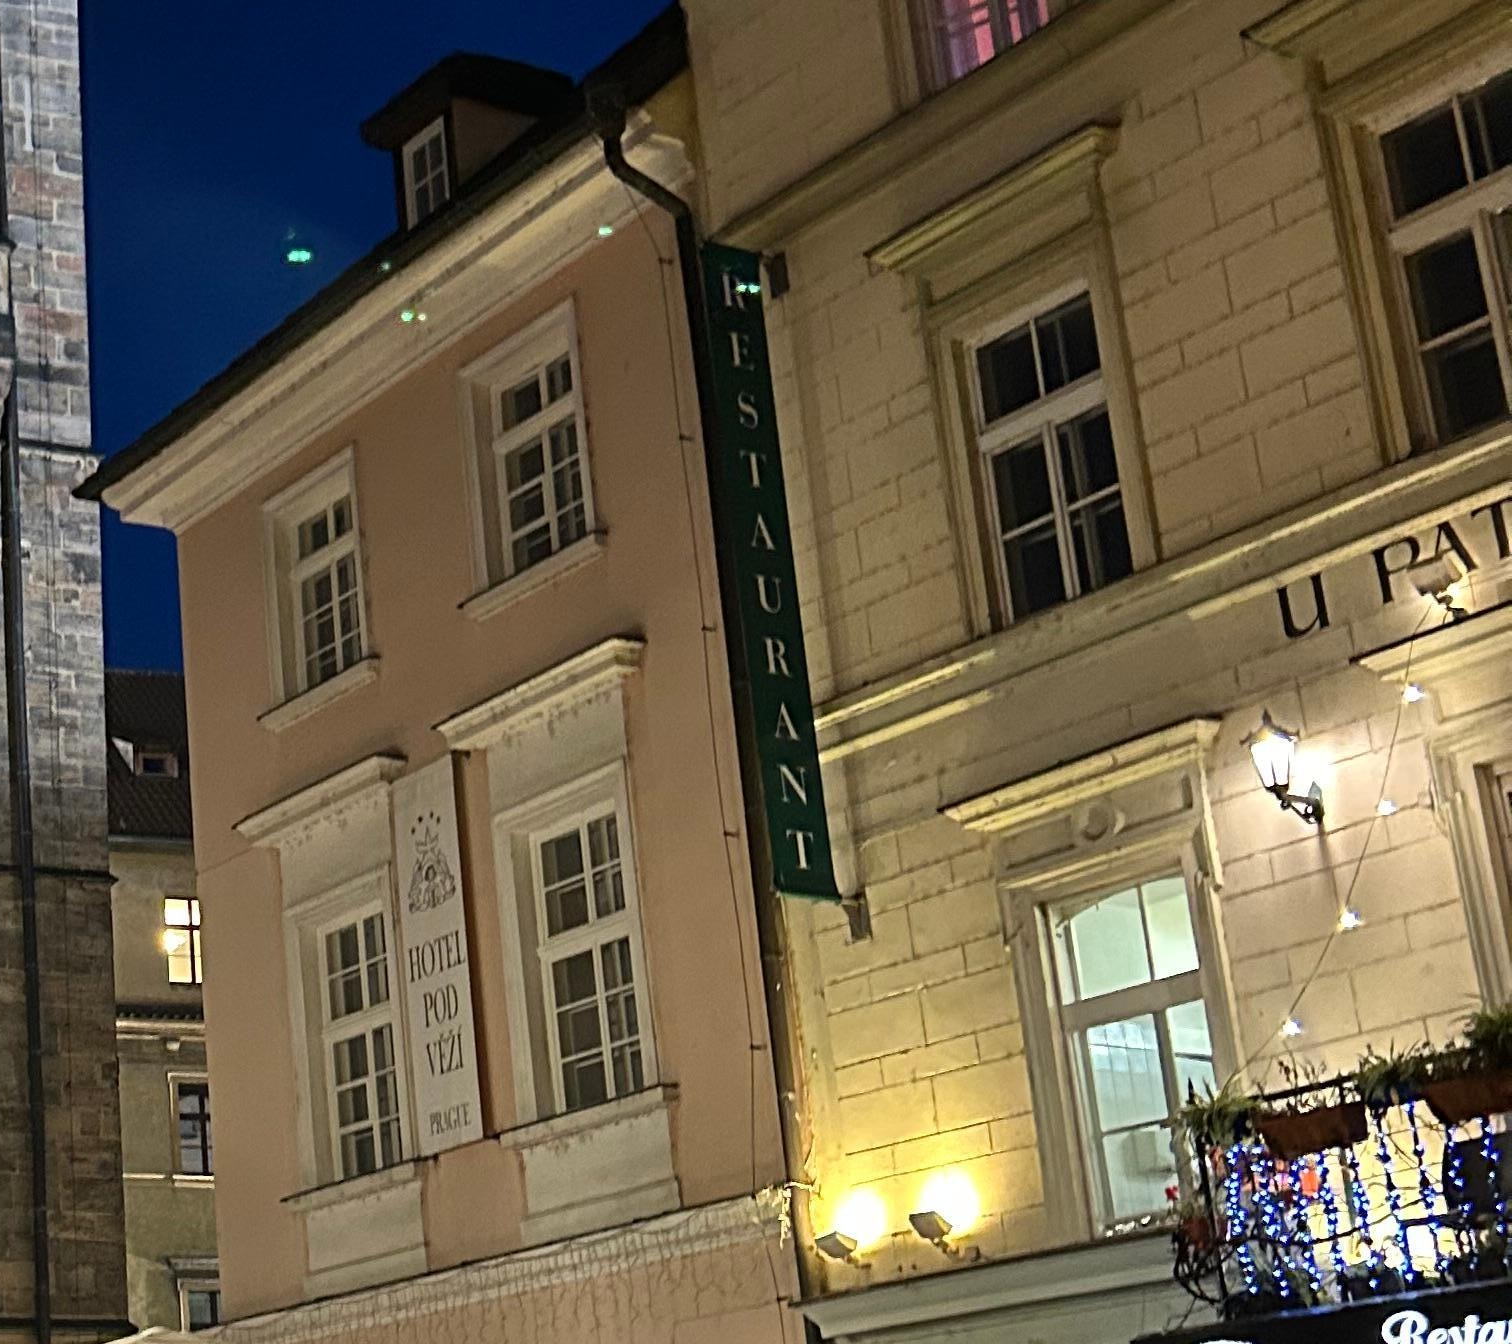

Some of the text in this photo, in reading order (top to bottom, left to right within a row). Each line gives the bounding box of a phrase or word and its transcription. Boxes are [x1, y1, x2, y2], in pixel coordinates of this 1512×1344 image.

[721, 272, 815, 870] RESTAURANT
[1277, 570, 1330, 638] U
[408, 930, 465, 983] HOTEL
[423, 983, 459, 1029] POD
[426, 1024, 465, 1077] VĚŽÍ
[429, 1103, 472, 1136] PRAGUE
